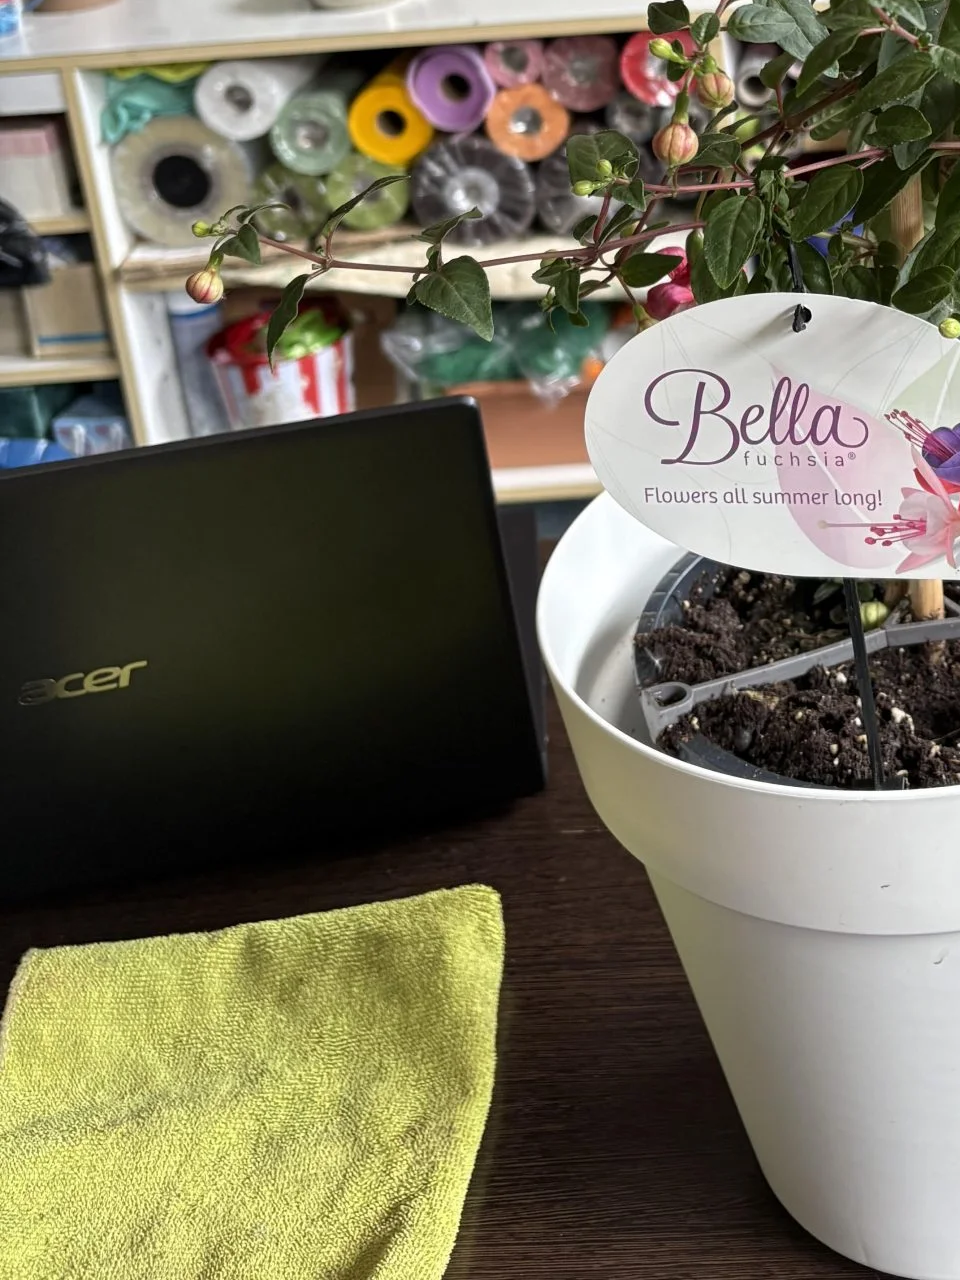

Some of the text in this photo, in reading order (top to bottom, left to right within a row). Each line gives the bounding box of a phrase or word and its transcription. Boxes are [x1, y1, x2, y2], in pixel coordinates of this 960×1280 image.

[644, 368, 869, 466] Bella
[644, 486, 883, 511] Flowers all summer long!
[18, 660, 148, 706] acer
